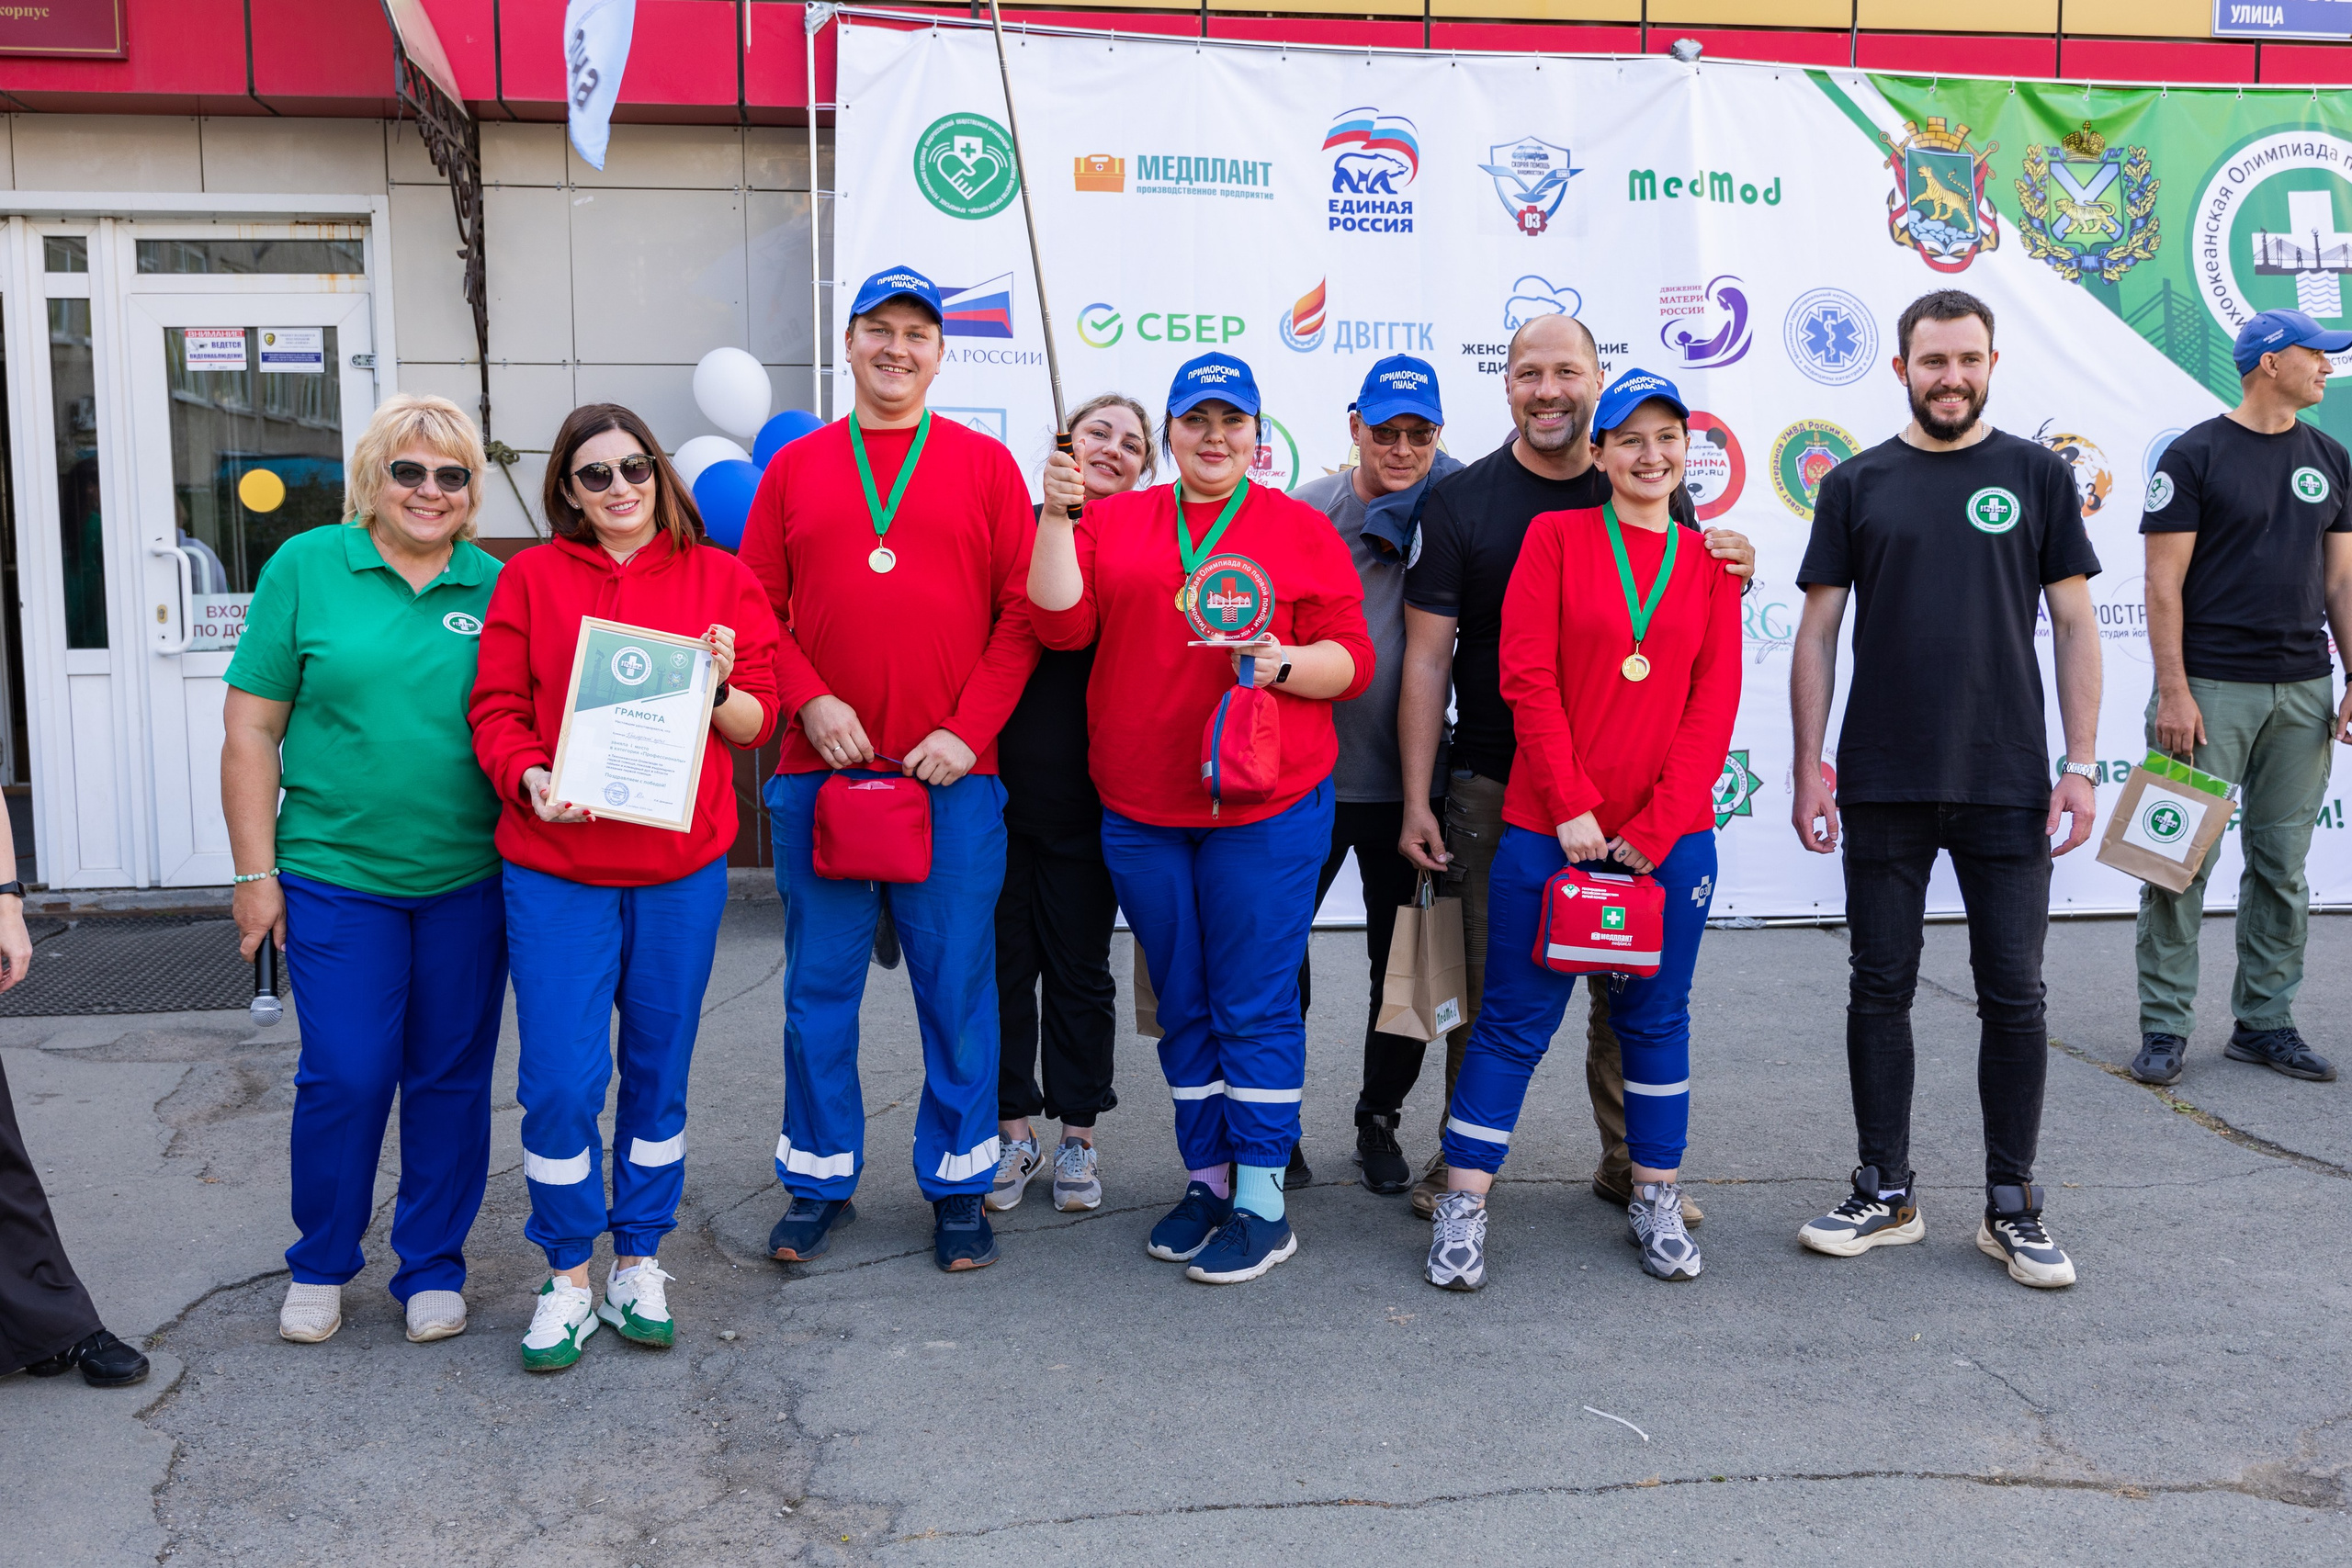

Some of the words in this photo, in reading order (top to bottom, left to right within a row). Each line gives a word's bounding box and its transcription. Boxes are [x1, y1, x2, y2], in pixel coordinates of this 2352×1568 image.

[2231, 5, 2285, 28] УЛИЦА
[1137, 154, 1272, 186] МЕДПЛАНТ
[2228, 142, 2338, 184] Олимпиада
[1136, 186, 1217, 196] производственное
[1220, 188, 1274, 200] предприятие
[1329, 199, 1413, 215] ЕДИНАЯ
[1329, 217, 1413, 232] РОССИЯ
[1525, 213, 1541, 228] 03
[891, 281, 918, 290] ПУЛЬС
[1660, 285, 1702, 293] ДВИЖЕНИЕ
[1659, 295, 1703, 304] МАТЕРИ
[1660, 307, 1704, 316] РОССИИ
[1136, 312, 1246, 344] СБЕР
[1333, 321, 1435, 354] ДВГГТК
[1462, 344, 1510, 355] ЖЕНС
[964, 349, 1042, 366] РОССИИ
[1187, 365, 1240, 379] ПРИМОРСКИЙ
[1200, 374, 1227, 384] ПУЛЬС
[1379, 370, 1429, 385] ПРИМОРСКИЙ
[1392, 380, 1418, 390] ПУЛЬС
[1781, 423, 1807, 442] УМВД
[1808, 421, 1840, 435] России
[1842, 434, 1853, 446] по
[1773, 443, 1784, 491] ветеранов
[1782, 493, 1805, 516] Совет
[1199, 559, 1241, 577] Олимпиада
[1242, 563, 1252, 572] по
[1251, 570, 1268, 596] первой
[1253, 597, 1268, 628] помощи
[194, 625, 218, 637] ПО
[2100, 630, 2129, 639] студия
[615, 707, 665, 723] ГРАМОТА
